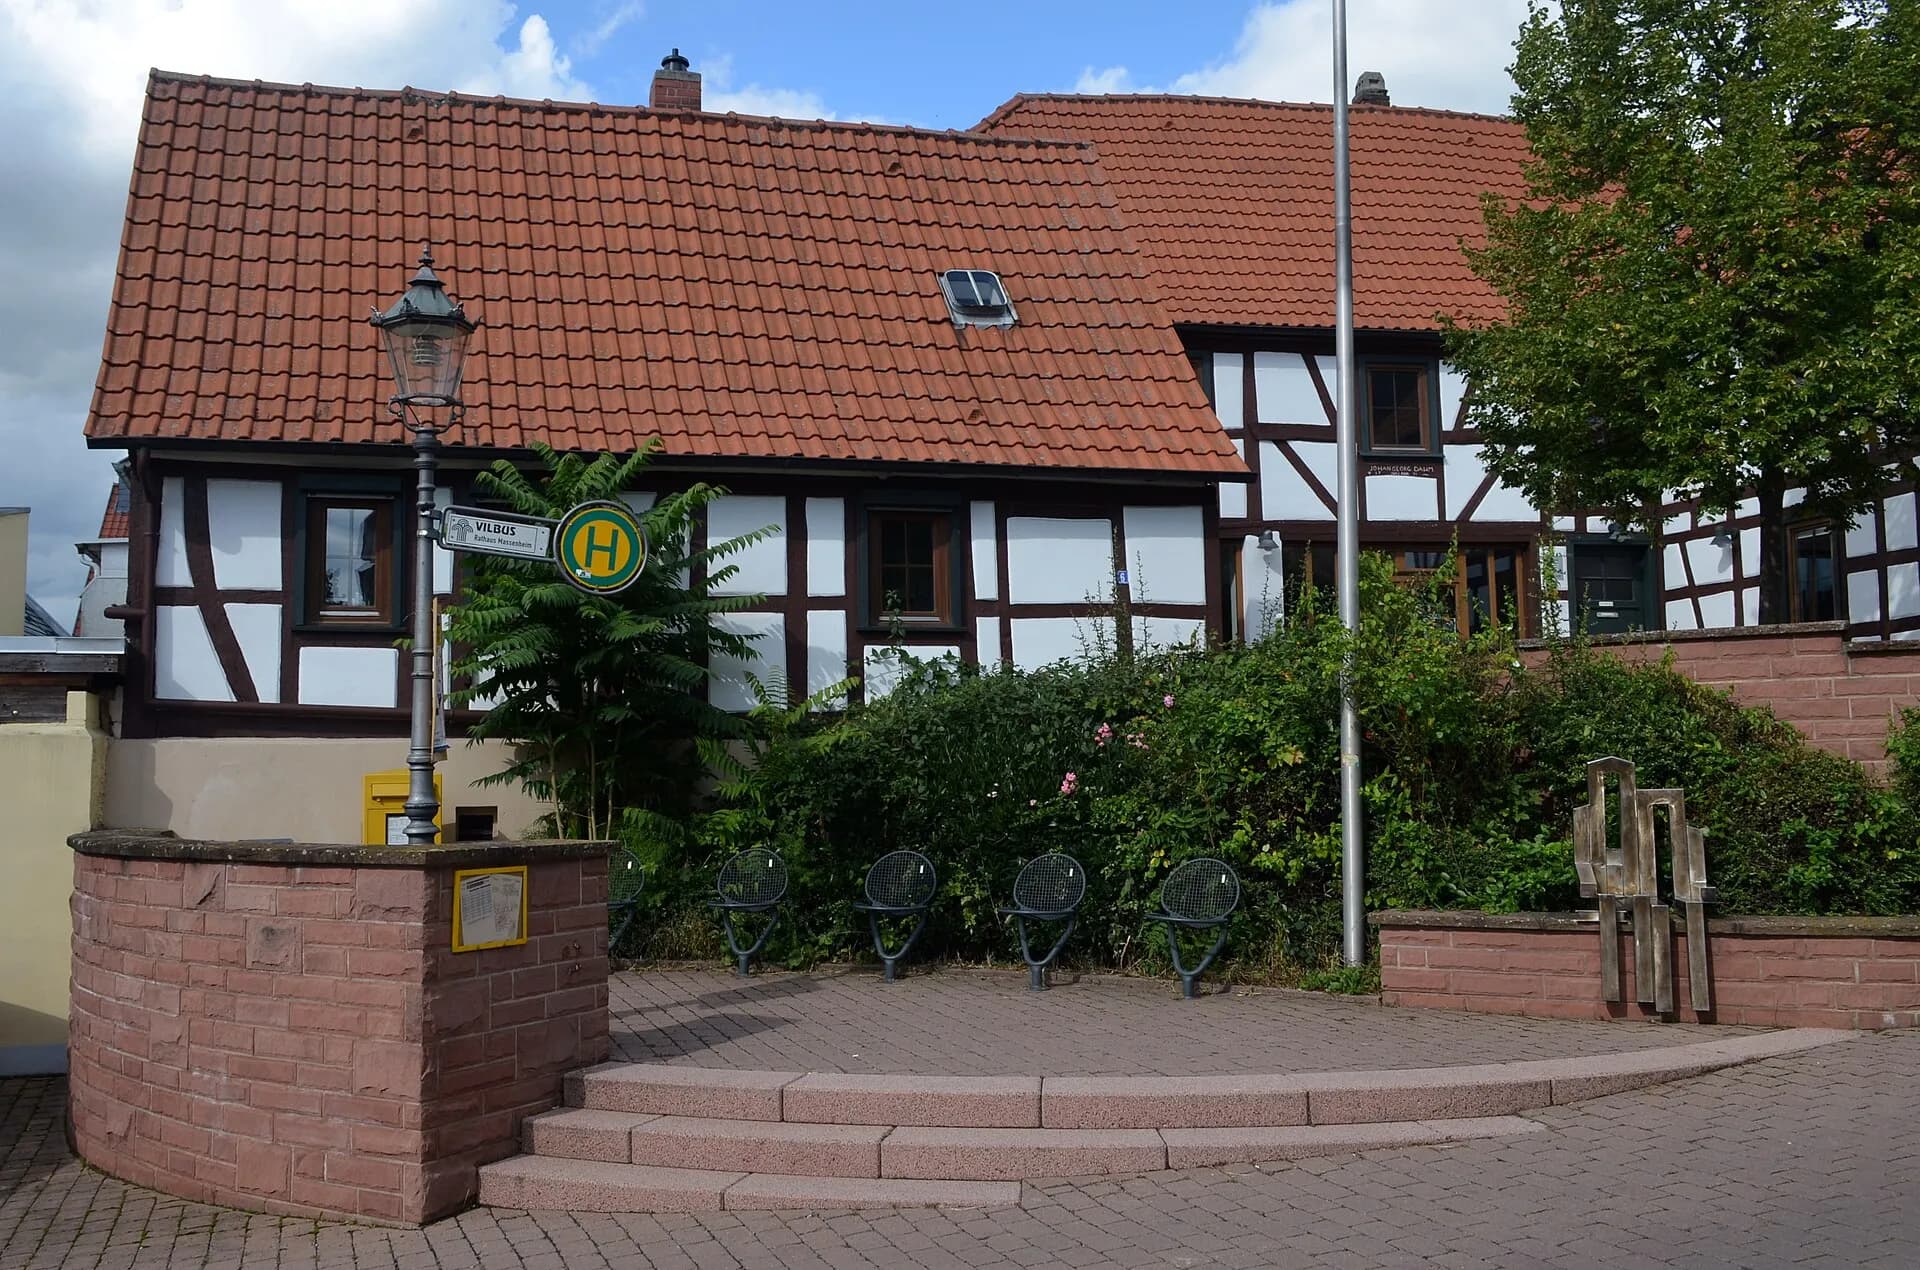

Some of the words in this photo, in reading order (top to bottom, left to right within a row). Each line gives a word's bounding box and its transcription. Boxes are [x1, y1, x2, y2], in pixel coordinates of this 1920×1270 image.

[476, 521, 516, 536] VILBUS
[474, 534, 497, 544] Rathaus
[498, 537, 532, 548] Massenheim
[584, 526, 619, 571] H
